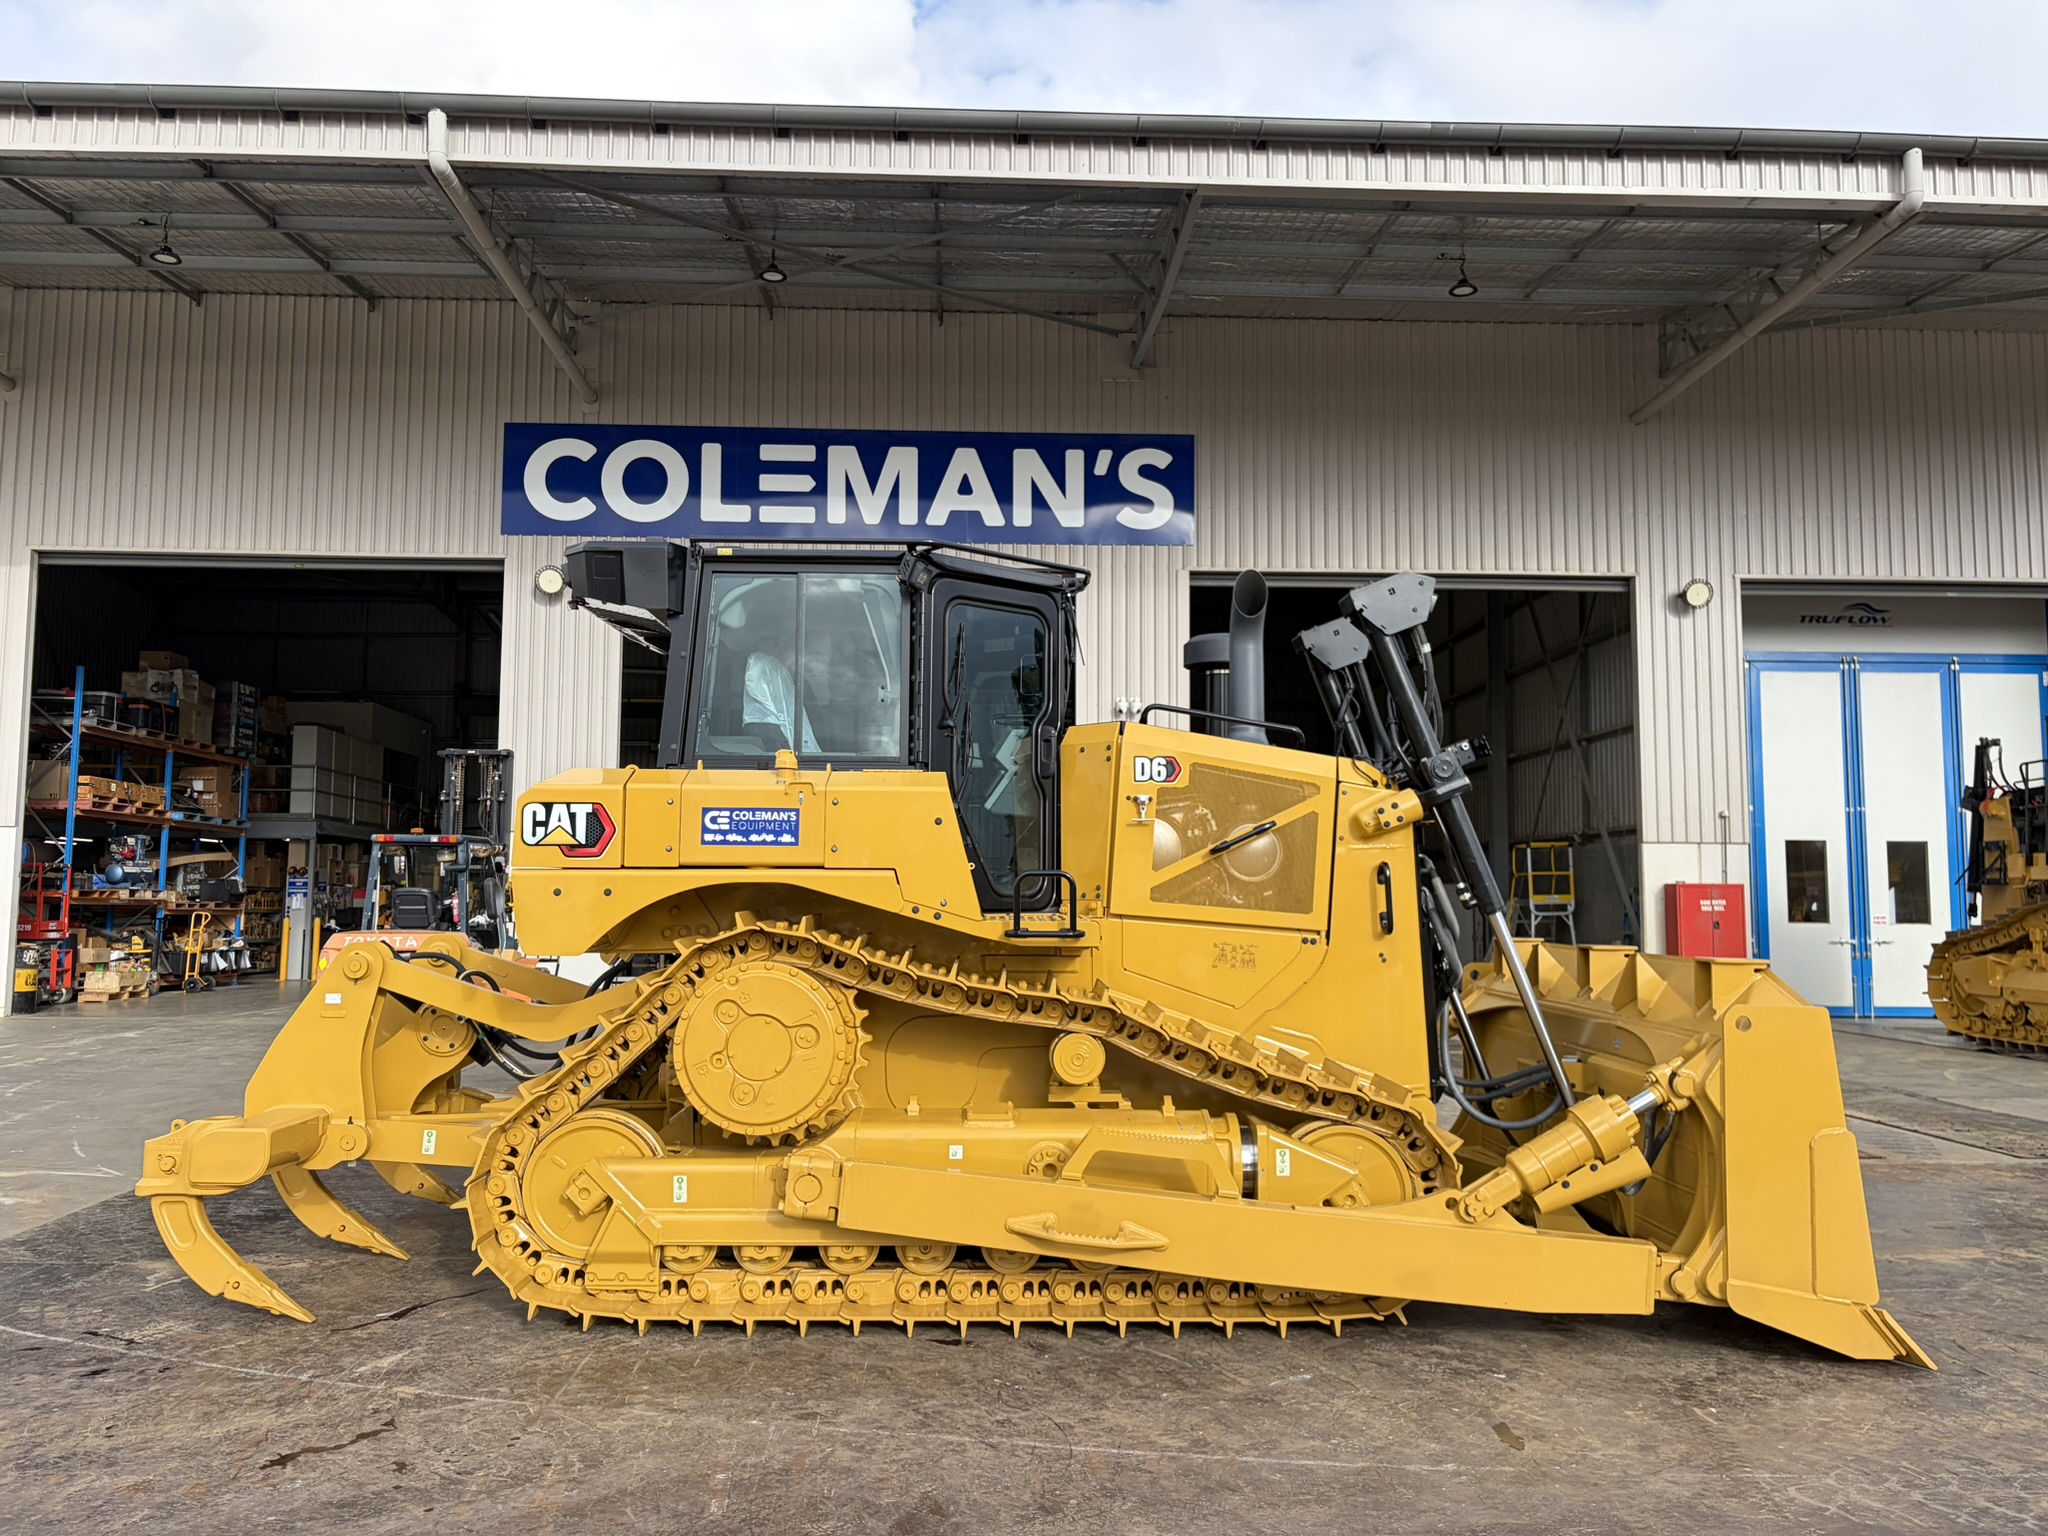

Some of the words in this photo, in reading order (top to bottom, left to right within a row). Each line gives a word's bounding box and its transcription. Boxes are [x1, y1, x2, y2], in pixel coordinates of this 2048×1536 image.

[524, 438, 1174, 530] COLEMAN'S
[1799, 615, 1892, 624] TRUFLOW
[1134, 756, 1168, 782] D6
[522, 803, 593, 846] CAT
[732, 810, 797, 821] COLEMAN'S
[731, 821, 797, 831] EQUIPMENT
